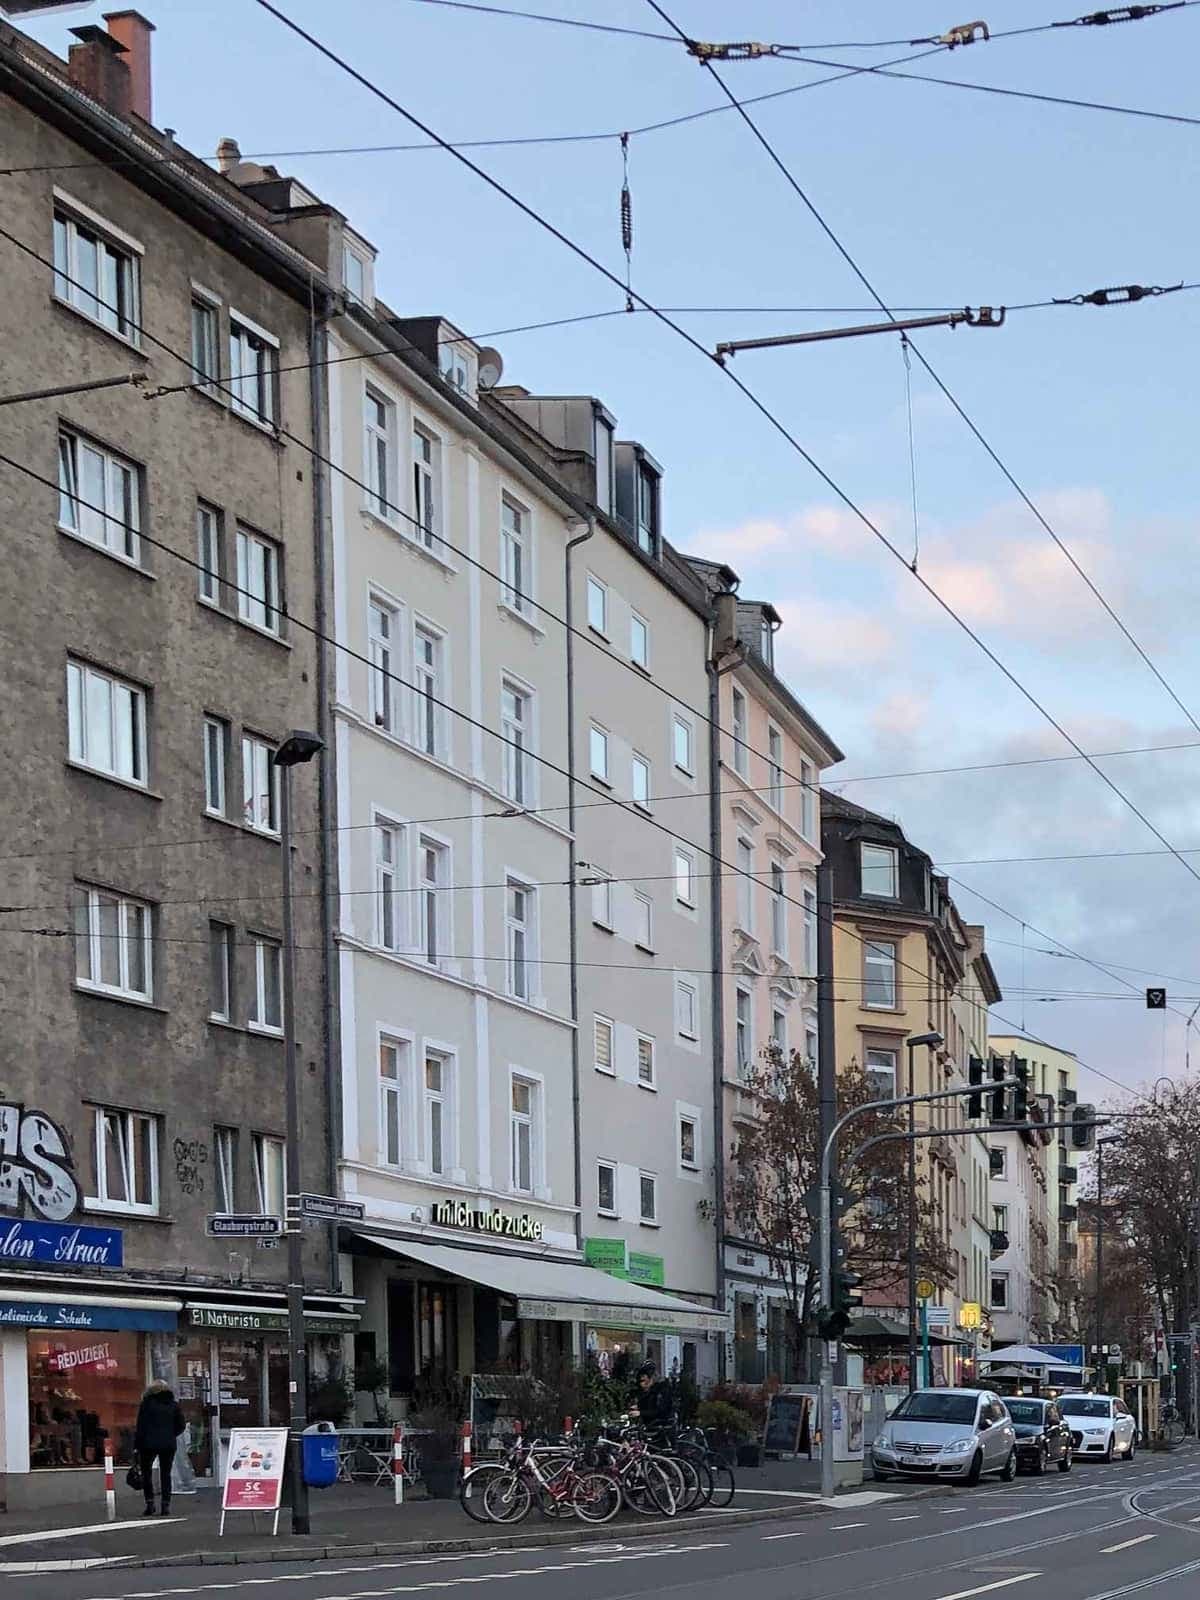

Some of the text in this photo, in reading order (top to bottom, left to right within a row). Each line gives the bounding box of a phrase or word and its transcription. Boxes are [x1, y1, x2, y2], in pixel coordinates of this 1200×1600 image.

[213, 1219, 276, 1234] Glauburgstraße
[437, 1200, 546, 1239] milch und zucker
[54, 1229, 112, 1264] Aruci
[54, 1307, 93, 1326] Schuhe
[192, 1309, 204, 1325] El
[207, 1311, 260, 1329] Naturista
[56, 1342, 111, 1370] REDUZIERT
